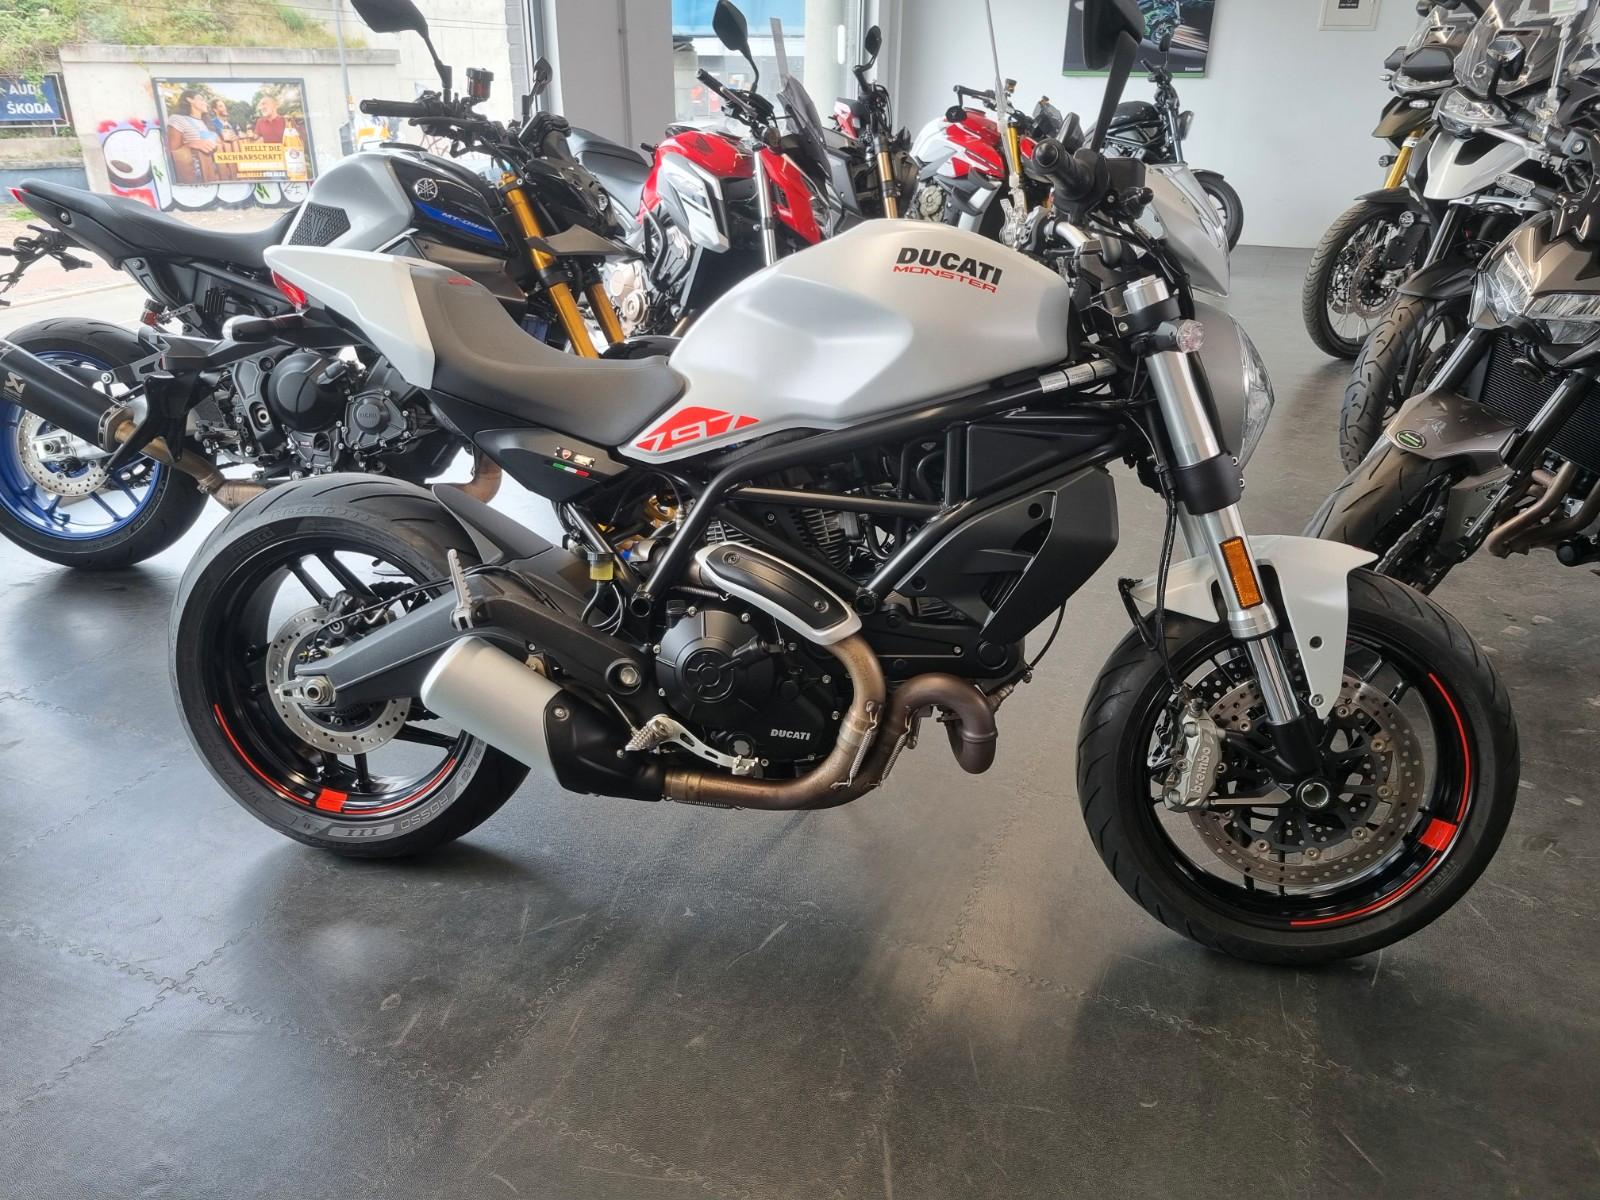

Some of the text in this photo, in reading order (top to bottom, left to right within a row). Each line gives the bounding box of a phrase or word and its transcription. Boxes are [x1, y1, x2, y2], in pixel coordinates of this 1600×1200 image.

[7, 101, 54, 114] ŠKODA
[217, 153, 281, 161] NACHBARSCHAFT
[893, 265, 997, 293] MONSTER
[896, 247, 1003, 286] DUCATI
[640, 412, 740, 452] 797
[770, 728, 811, 740] DUCATI
[1190, 746, 1212, 793] brembo
